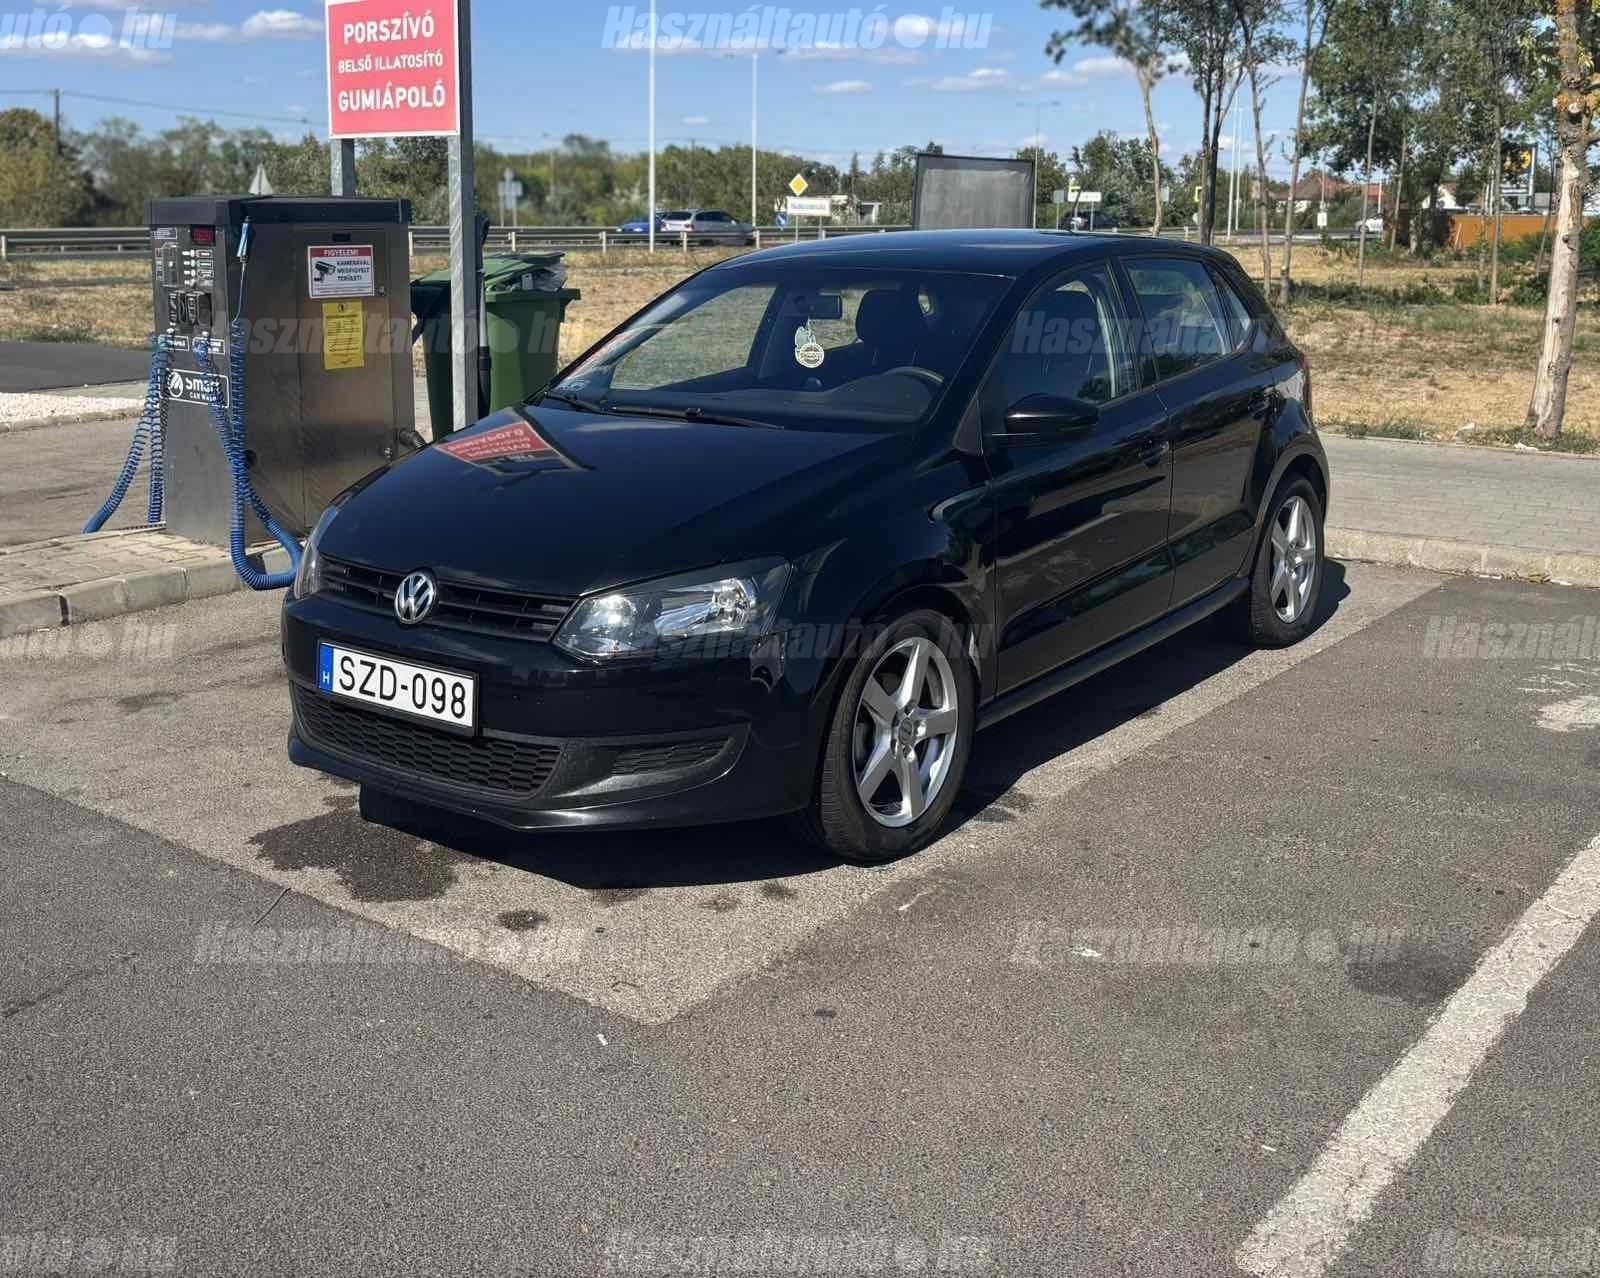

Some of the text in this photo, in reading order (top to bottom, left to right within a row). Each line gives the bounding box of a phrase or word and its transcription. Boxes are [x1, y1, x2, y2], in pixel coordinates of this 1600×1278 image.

[343, 9, 435, 46] PORSZÍVÓ
[375, 48, 443, 70] ILLATOSÍTÓ
[338, 79, 446, 112] GUMIÁPOLÓ
[339, 656, 466, 719] SZD-098
